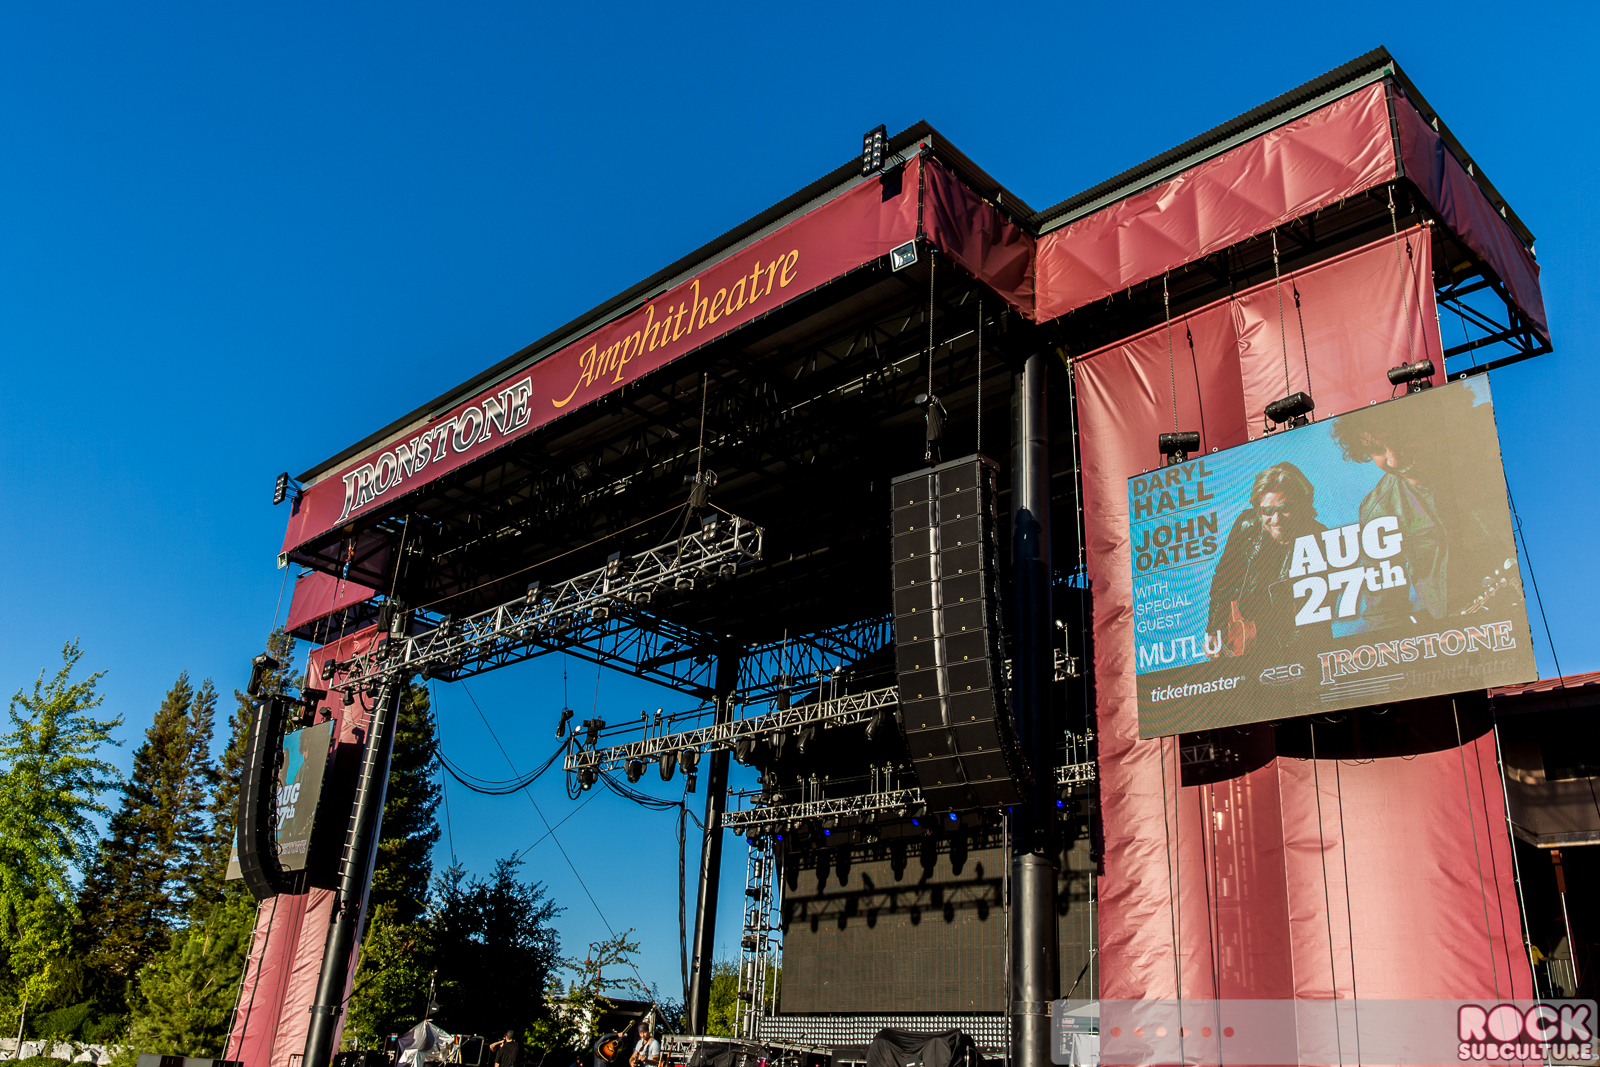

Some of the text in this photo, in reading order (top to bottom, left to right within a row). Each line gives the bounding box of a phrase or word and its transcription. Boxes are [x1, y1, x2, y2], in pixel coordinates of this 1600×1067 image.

[333, 249, 799, 525] IRONSTONE Amphitheatre
[1133, 460, 1214, 497] DARYL
[1134, 480, 1215, 520] HALL
[1135, 511, 1219, 553] JOHN
[1288, 515, 1403, 578] AUG
[1136, 535, 1218, 571] OATES
[1135, 581, 1169, 599] WITH
[1136, 594, 1192, 615] SPECIAL
[1292, 560, 1407, 626] 27th
[1137, 613, 1182, 633] GUEST
[1139, 630, 1222, 668] MUTLU
[1317, 620, 1517, 685] IRONSTONE
[1150, 676, 1240, 702] ticketmaster
